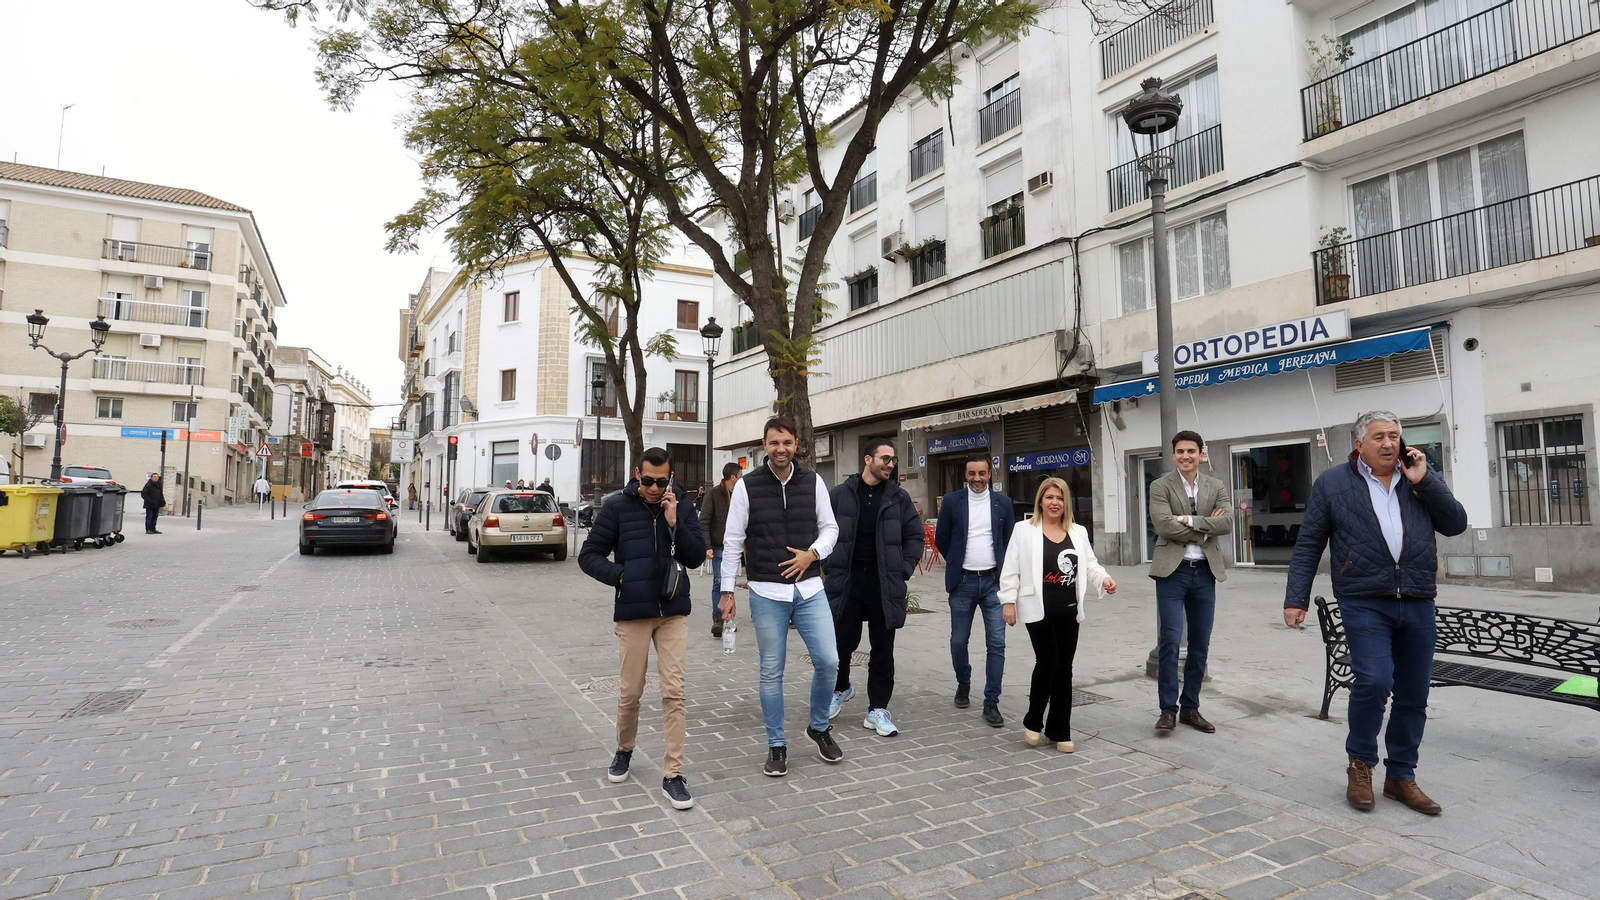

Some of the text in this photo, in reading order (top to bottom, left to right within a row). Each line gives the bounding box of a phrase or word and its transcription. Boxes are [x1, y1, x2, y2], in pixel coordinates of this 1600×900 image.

[1174, 317, 1330, 365] ORTOPEDIA
[1175, 349, 1337, 387] OPEDIA MEDICA JEREZANA
[957, 405, 1003, 420] BAR SERRANO
[949, 436, 976, 448] SERRANO
[1035, 453, 1070, 466] SERRANO
